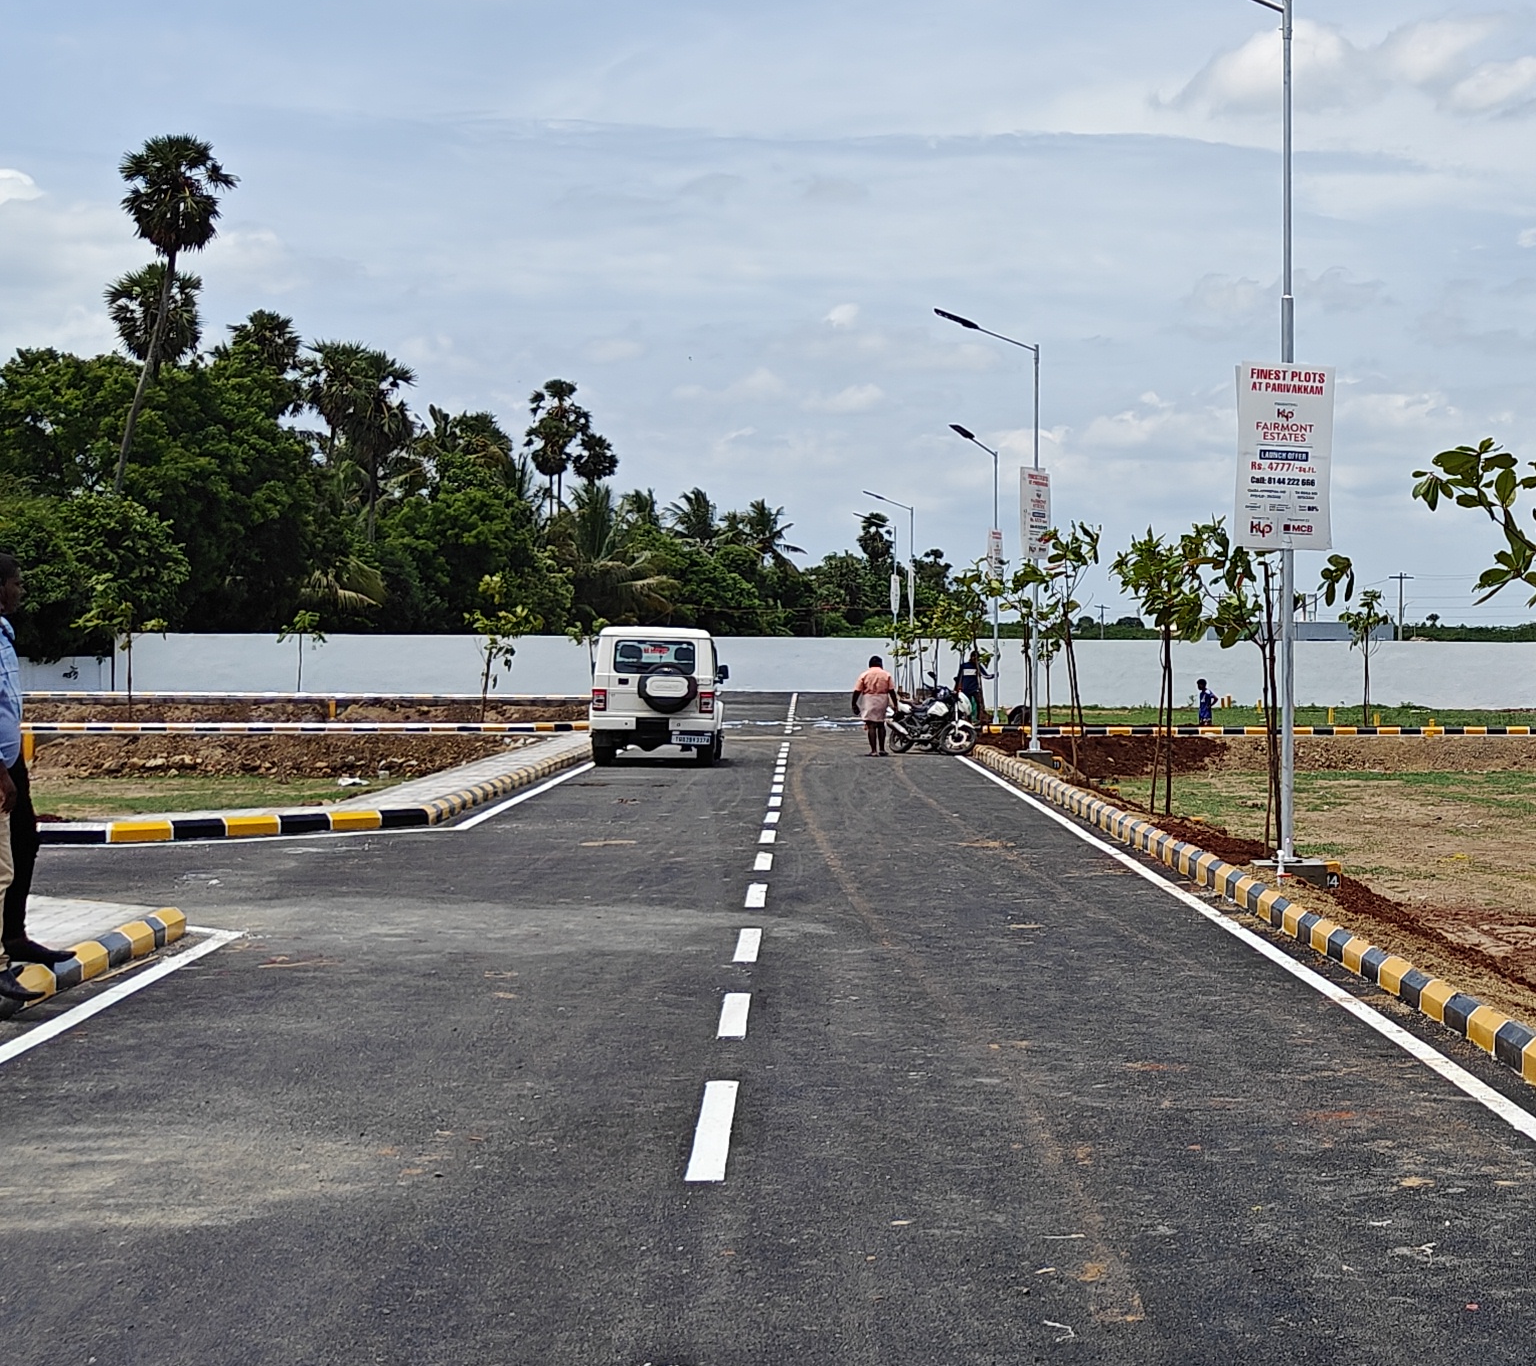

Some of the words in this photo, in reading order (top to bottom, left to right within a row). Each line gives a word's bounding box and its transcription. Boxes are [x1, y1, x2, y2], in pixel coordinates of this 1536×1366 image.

[1250, 367, 1288, 381] FINEST
[1290, 370, 1326, 384] PLOTS
[1251, 381, 1263, 392] AT
[1265, 382, 1324, 396] PARIVAKKAM
[1255, 421, 1315, 433] FAIRMONT
[1262, 432, 1307, 443] ESTATES
[1261, 450, 1287, 460] LAUNCH
[1287, 452, 1307, 461] OFFER
[1250, 461, 1266, 471] Rs.
[1250, 476, 1266, 485] Call:
[1286, 478, 1300, 486] 222
[1292, 524, 1314, 533] MCB
[1326, 874, 1340, 887] 14
